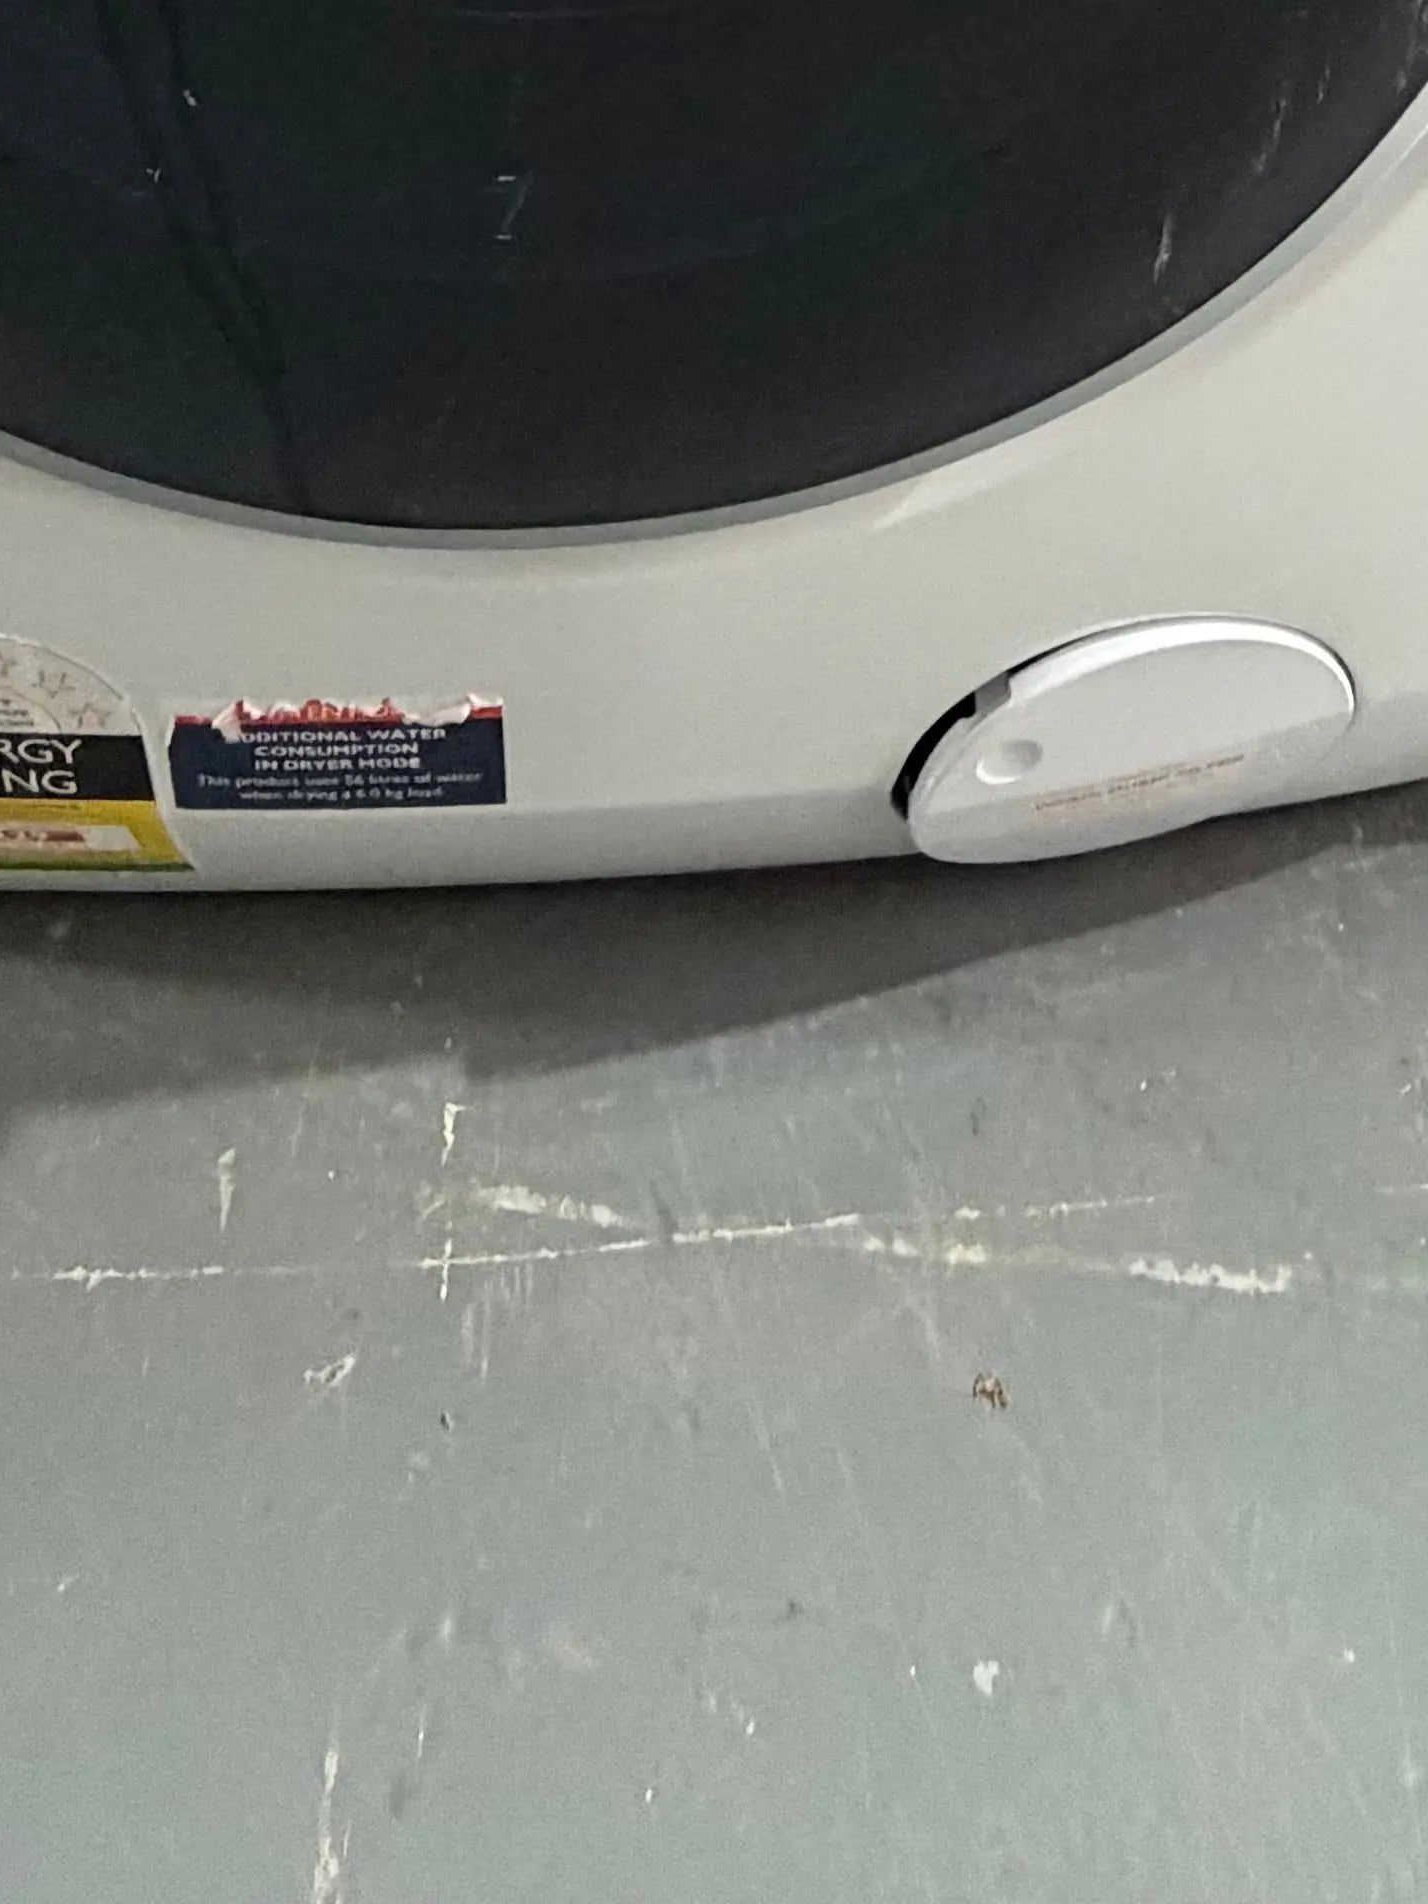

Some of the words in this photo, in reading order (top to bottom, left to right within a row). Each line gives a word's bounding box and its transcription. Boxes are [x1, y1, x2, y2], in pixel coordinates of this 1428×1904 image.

[239, 729, 360, 742] DDITIONAL
[366, 728, 447, 741] WATER
[253, 742, 420, 757] CONSUMPTION
[254, 758, 280, 771] IN
[282, 758, 353, 771] DRYER
[358, 757, 422, 770] MODE
